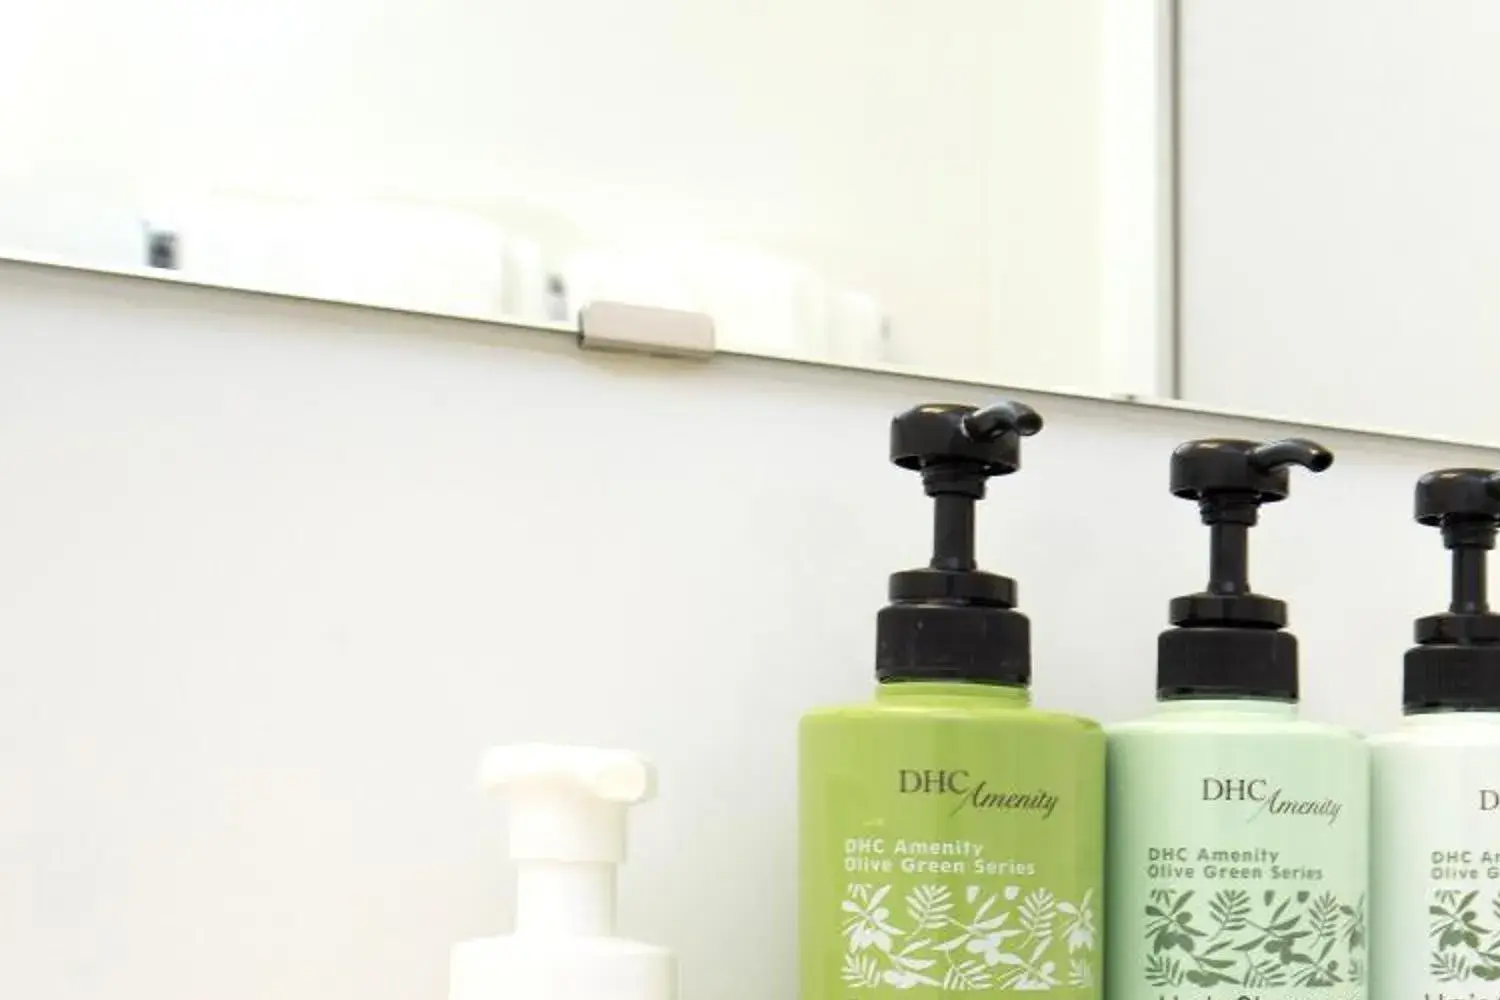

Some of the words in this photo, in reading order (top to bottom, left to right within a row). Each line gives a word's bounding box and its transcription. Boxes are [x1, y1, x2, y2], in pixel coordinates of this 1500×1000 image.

[899, 769, 970, 794] DHC
[950, 781, 1059, 820] Amenity
[1202, 778, 1267, 801] DHC
[1246, 788, 1342, 827] Amenity
[844, 838, 885, 854] DHC
[894, 840, 983, 857] Amenity
[1148, 847, 1188, 862] DHC
[1197, 848, 1280, 864] Amenity
[1431, 850, 1472, 864] DHC
[844, 857, 892, 873] Olive
[902, 857, 965, 874] Green
[975, 859, 1036, 876] Series
[1147, 864, 1195, 879] Olive
[1203, 865, 1263, 879] Green
[1271, 865, 1323, 880] Series
[1431, 866, 1479, 880] Olive
